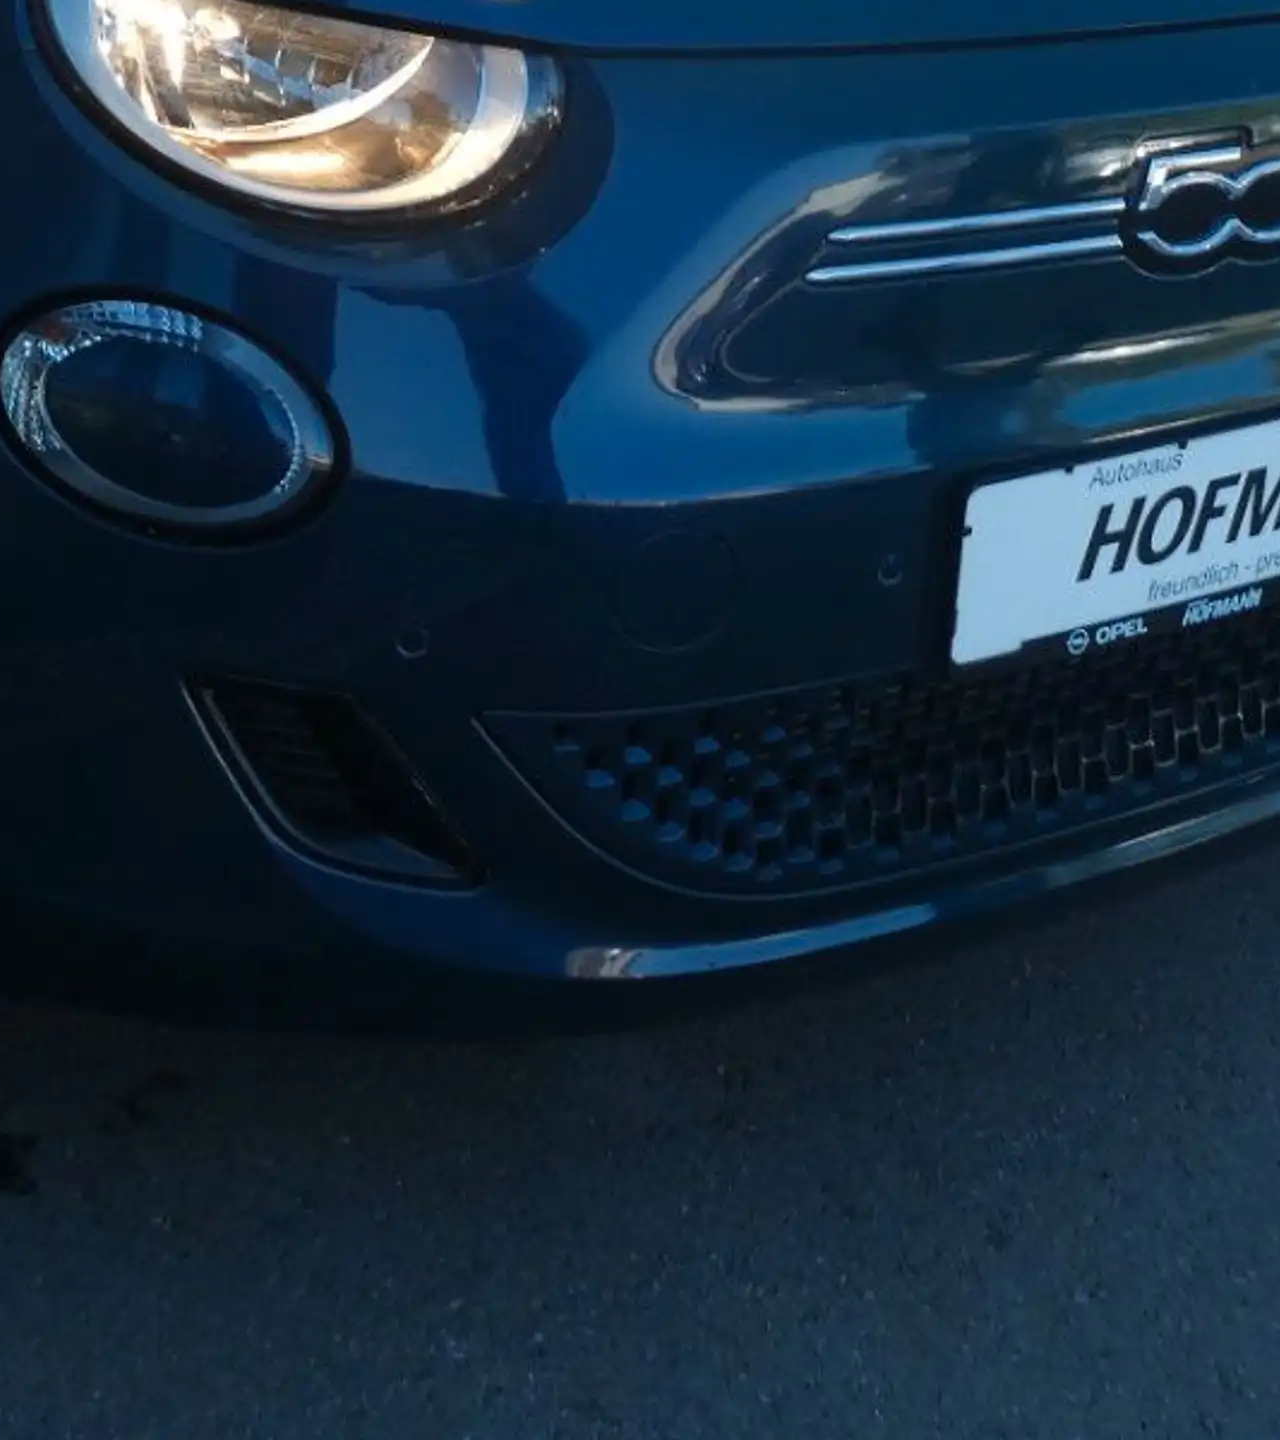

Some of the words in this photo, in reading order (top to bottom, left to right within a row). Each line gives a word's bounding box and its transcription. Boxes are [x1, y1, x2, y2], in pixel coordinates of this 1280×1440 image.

[1088, 452, 1184, 490] Autohaus
[1147, 559, 1240, 602] freundlich
[1095, 615, 1149, 645] OPEL
